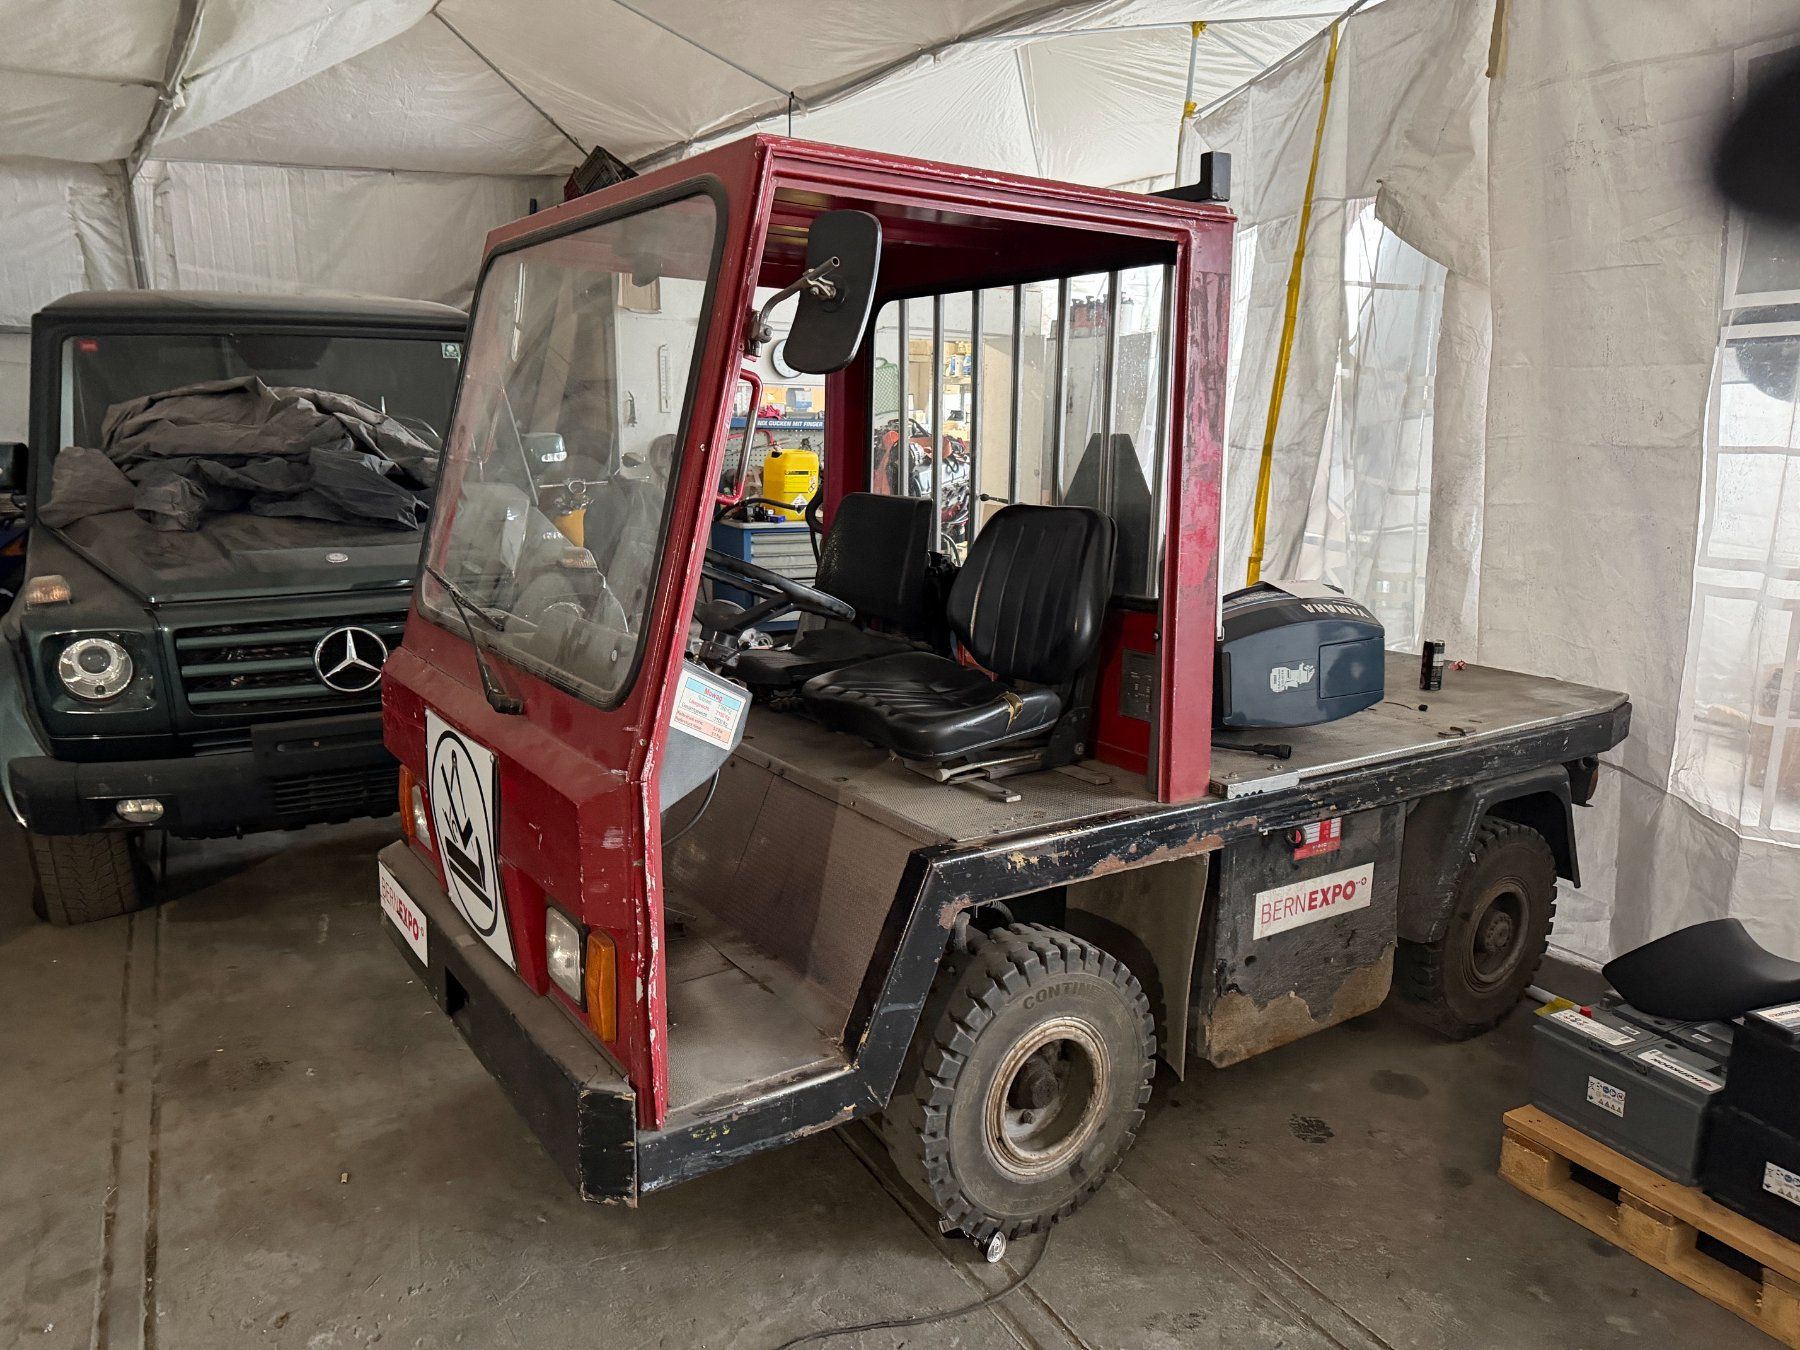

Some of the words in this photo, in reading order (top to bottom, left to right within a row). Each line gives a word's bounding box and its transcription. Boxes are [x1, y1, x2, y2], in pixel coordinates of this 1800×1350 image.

[1301, 603, 1370, 619] YAMAHA
[703, 687, 723, 704] Mowag
[381, 876, 419, 941] BERNEXPO
[1261, 880, 1356, 925] BERNEXPO
